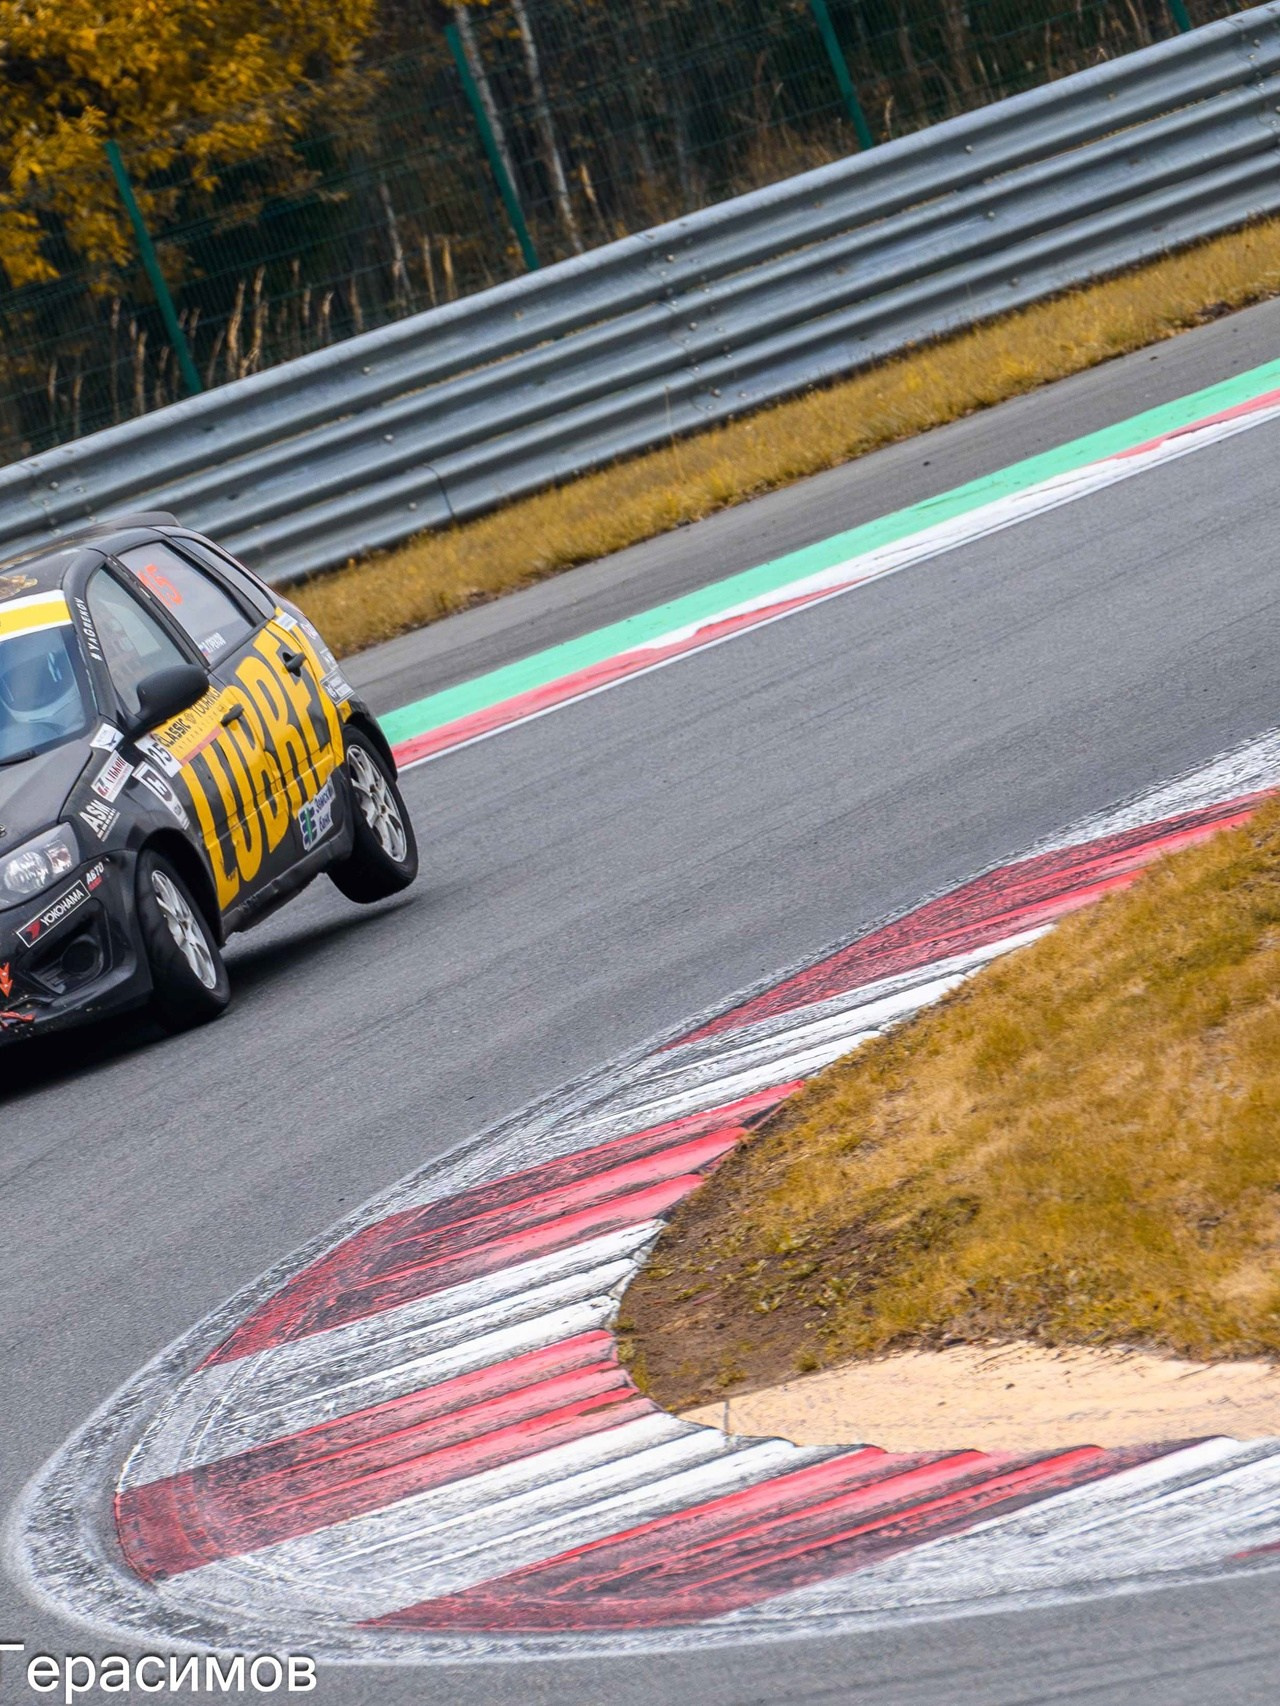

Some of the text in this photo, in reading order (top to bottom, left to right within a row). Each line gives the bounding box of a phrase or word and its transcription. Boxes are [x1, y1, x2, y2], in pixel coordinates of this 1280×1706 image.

[137, 563, 183, 609] 15
[160, 718, 191, 748] CLASSIC
[146, 742, 172, 767] 15
[80, 799, 111, 834] ASM
[40, 888, 84, 926] YOKOHAMA
